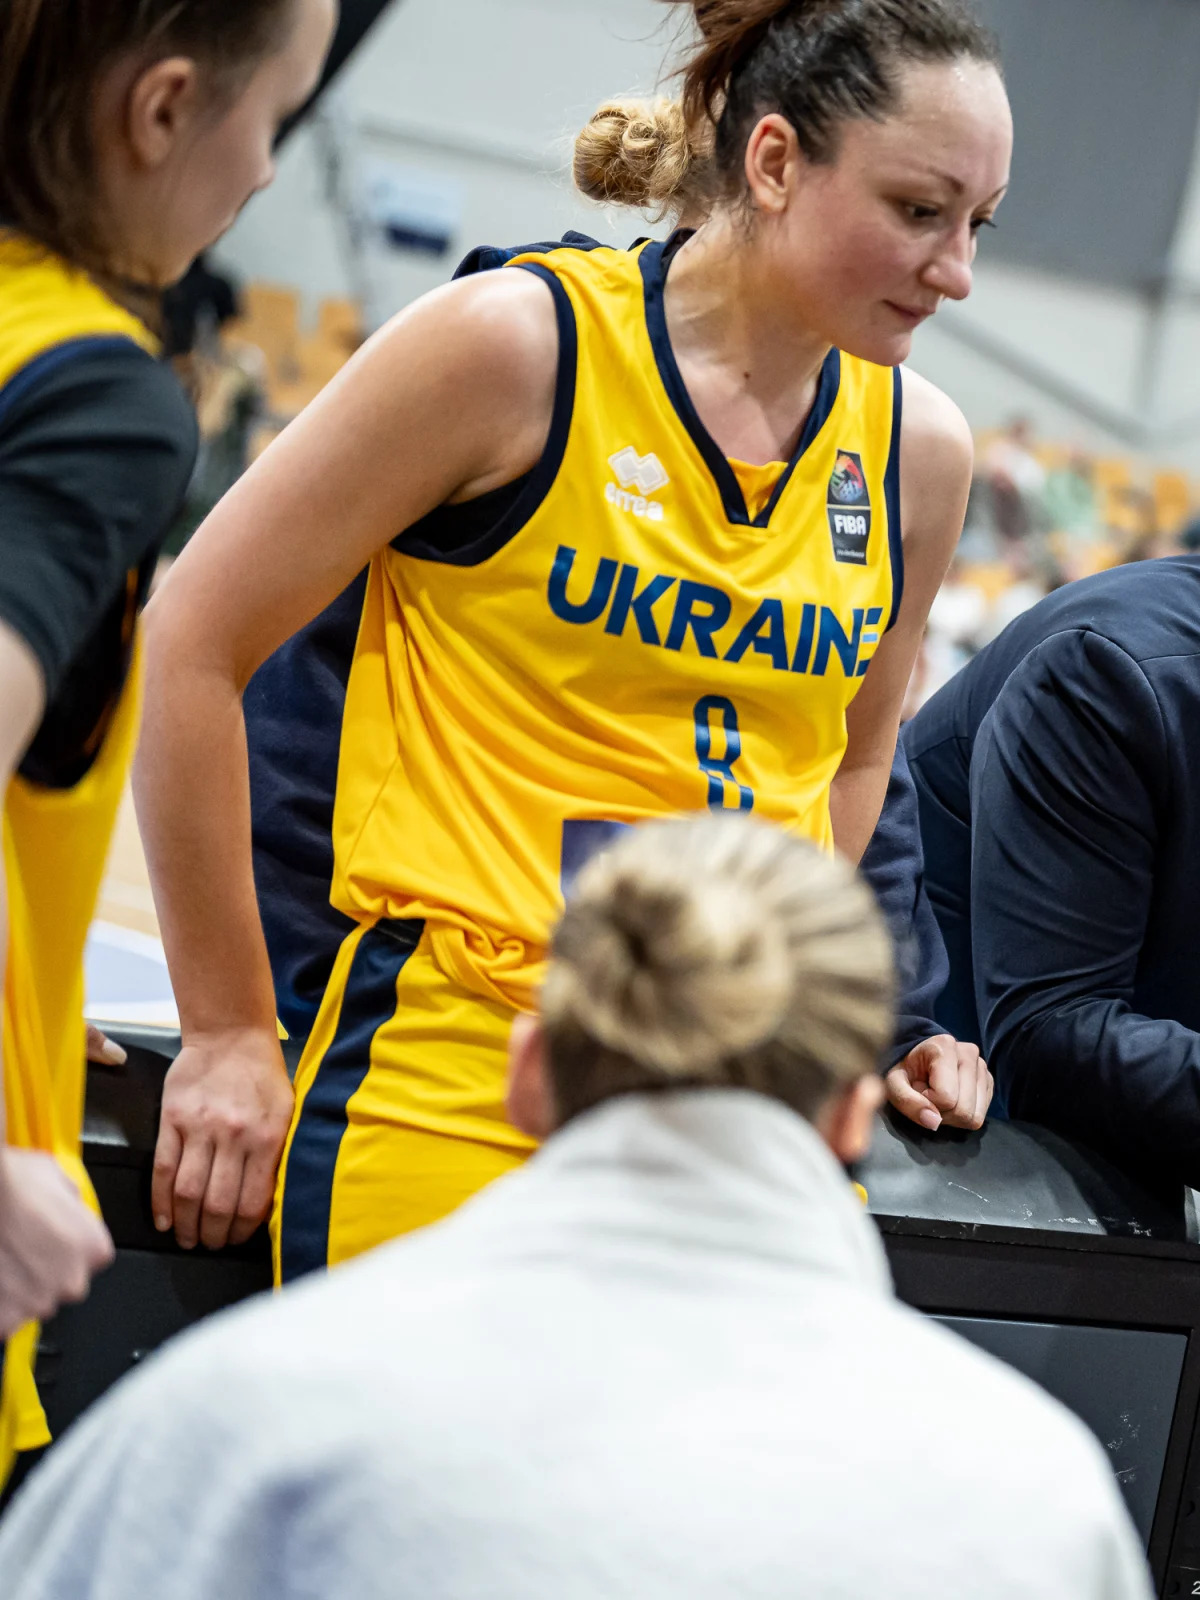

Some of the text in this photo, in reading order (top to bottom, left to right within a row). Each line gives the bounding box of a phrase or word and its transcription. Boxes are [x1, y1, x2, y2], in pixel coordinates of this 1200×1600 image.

[834, 514, 867, 536] FIBA
[547, 544, 883, 678] UKRAINE
[693, 695, 754, 816] 8
